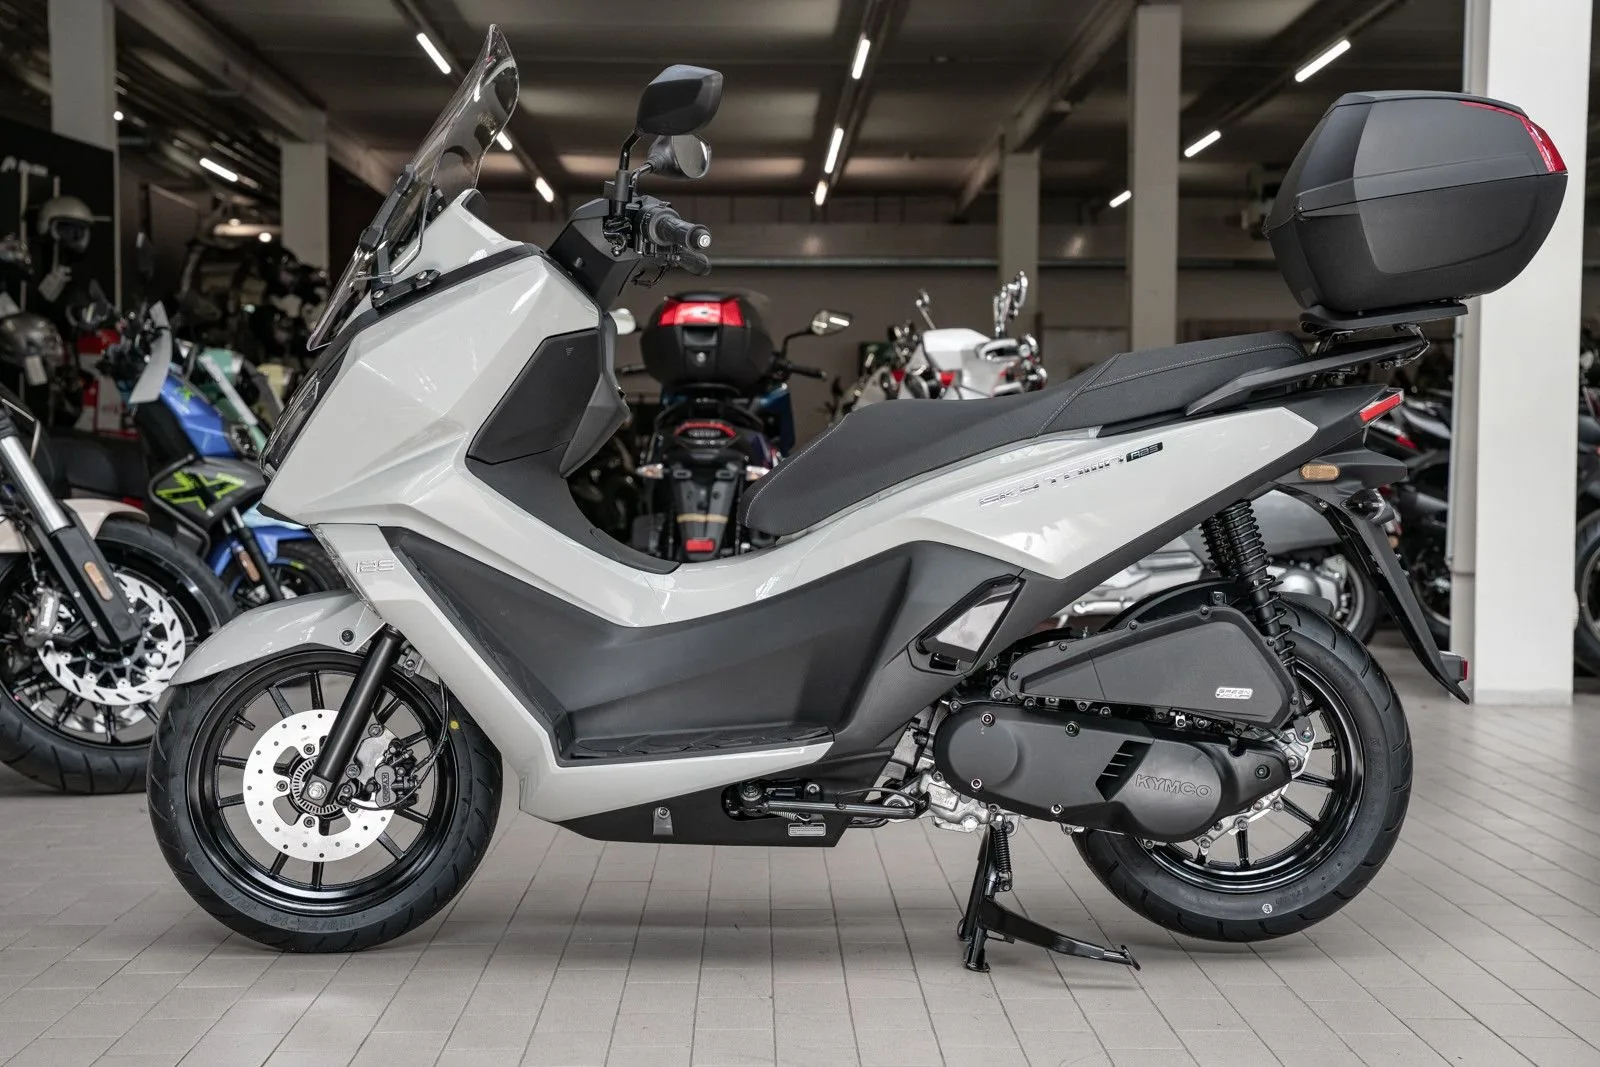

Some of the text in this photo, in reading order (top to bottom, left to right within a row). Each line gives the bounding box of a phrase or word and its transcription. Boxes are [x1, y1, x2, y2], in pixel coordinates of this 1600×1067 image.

[1130, 444, 1159, 461] ABS
[355, 559, 395, 573] 125
[1135, 773, 1212, 799] KYMCO
